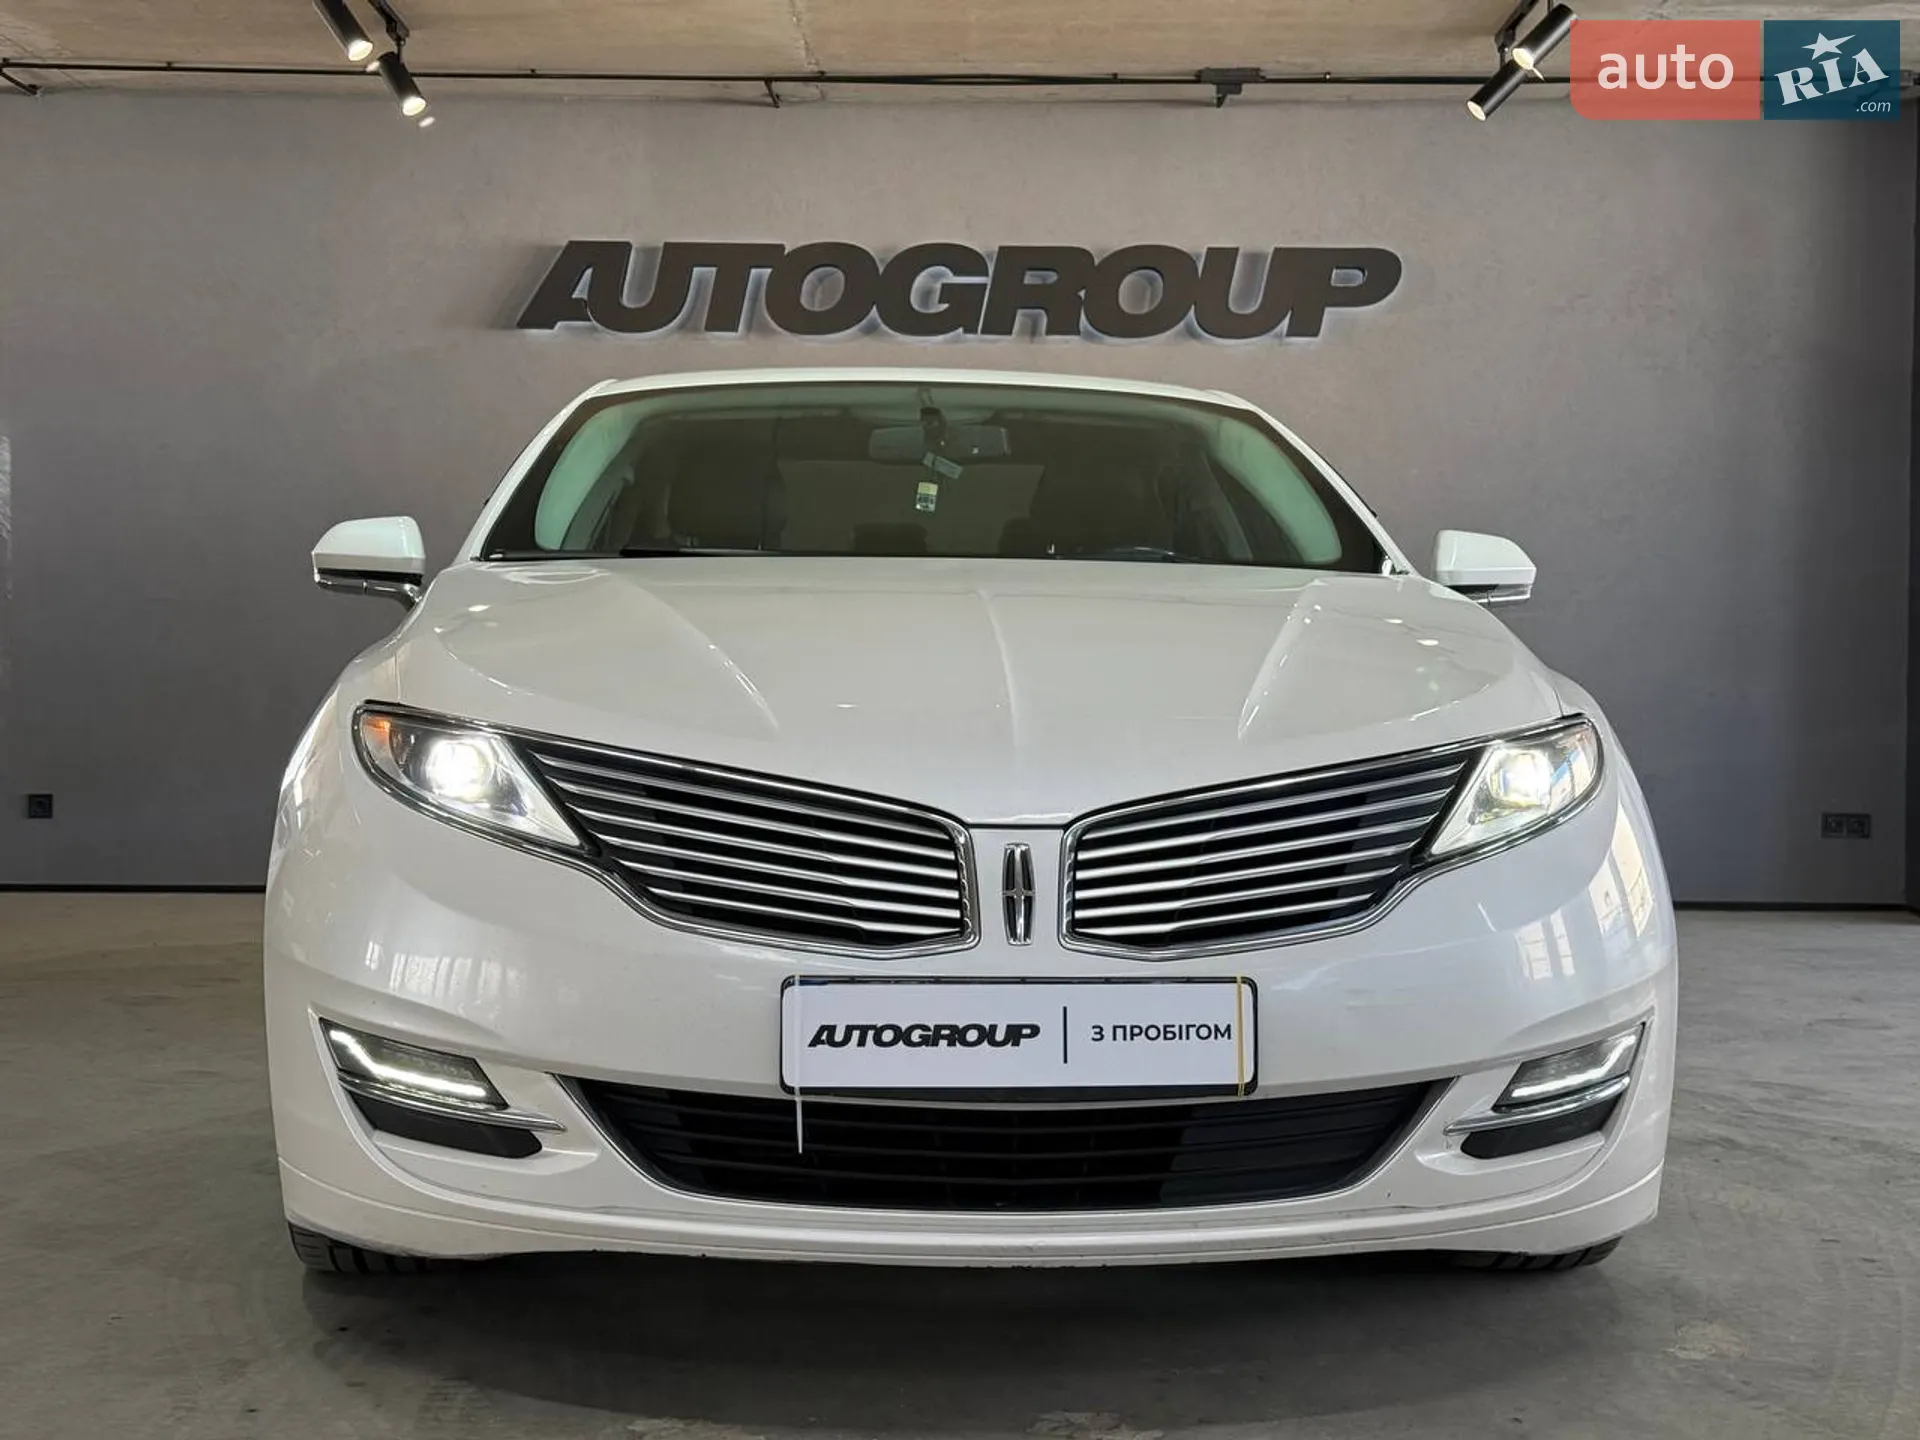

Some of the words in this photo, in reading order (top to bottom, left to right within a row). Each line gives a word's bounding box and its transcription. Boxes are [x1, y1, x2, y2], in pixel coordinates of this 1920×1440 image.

[516, 240, 1402, 338] AUTOGROUP
[808, 1023, 1041, 1048] AUTOGROUP
[1112, 1023, 1231, 1041] ПРОБІГОМ
